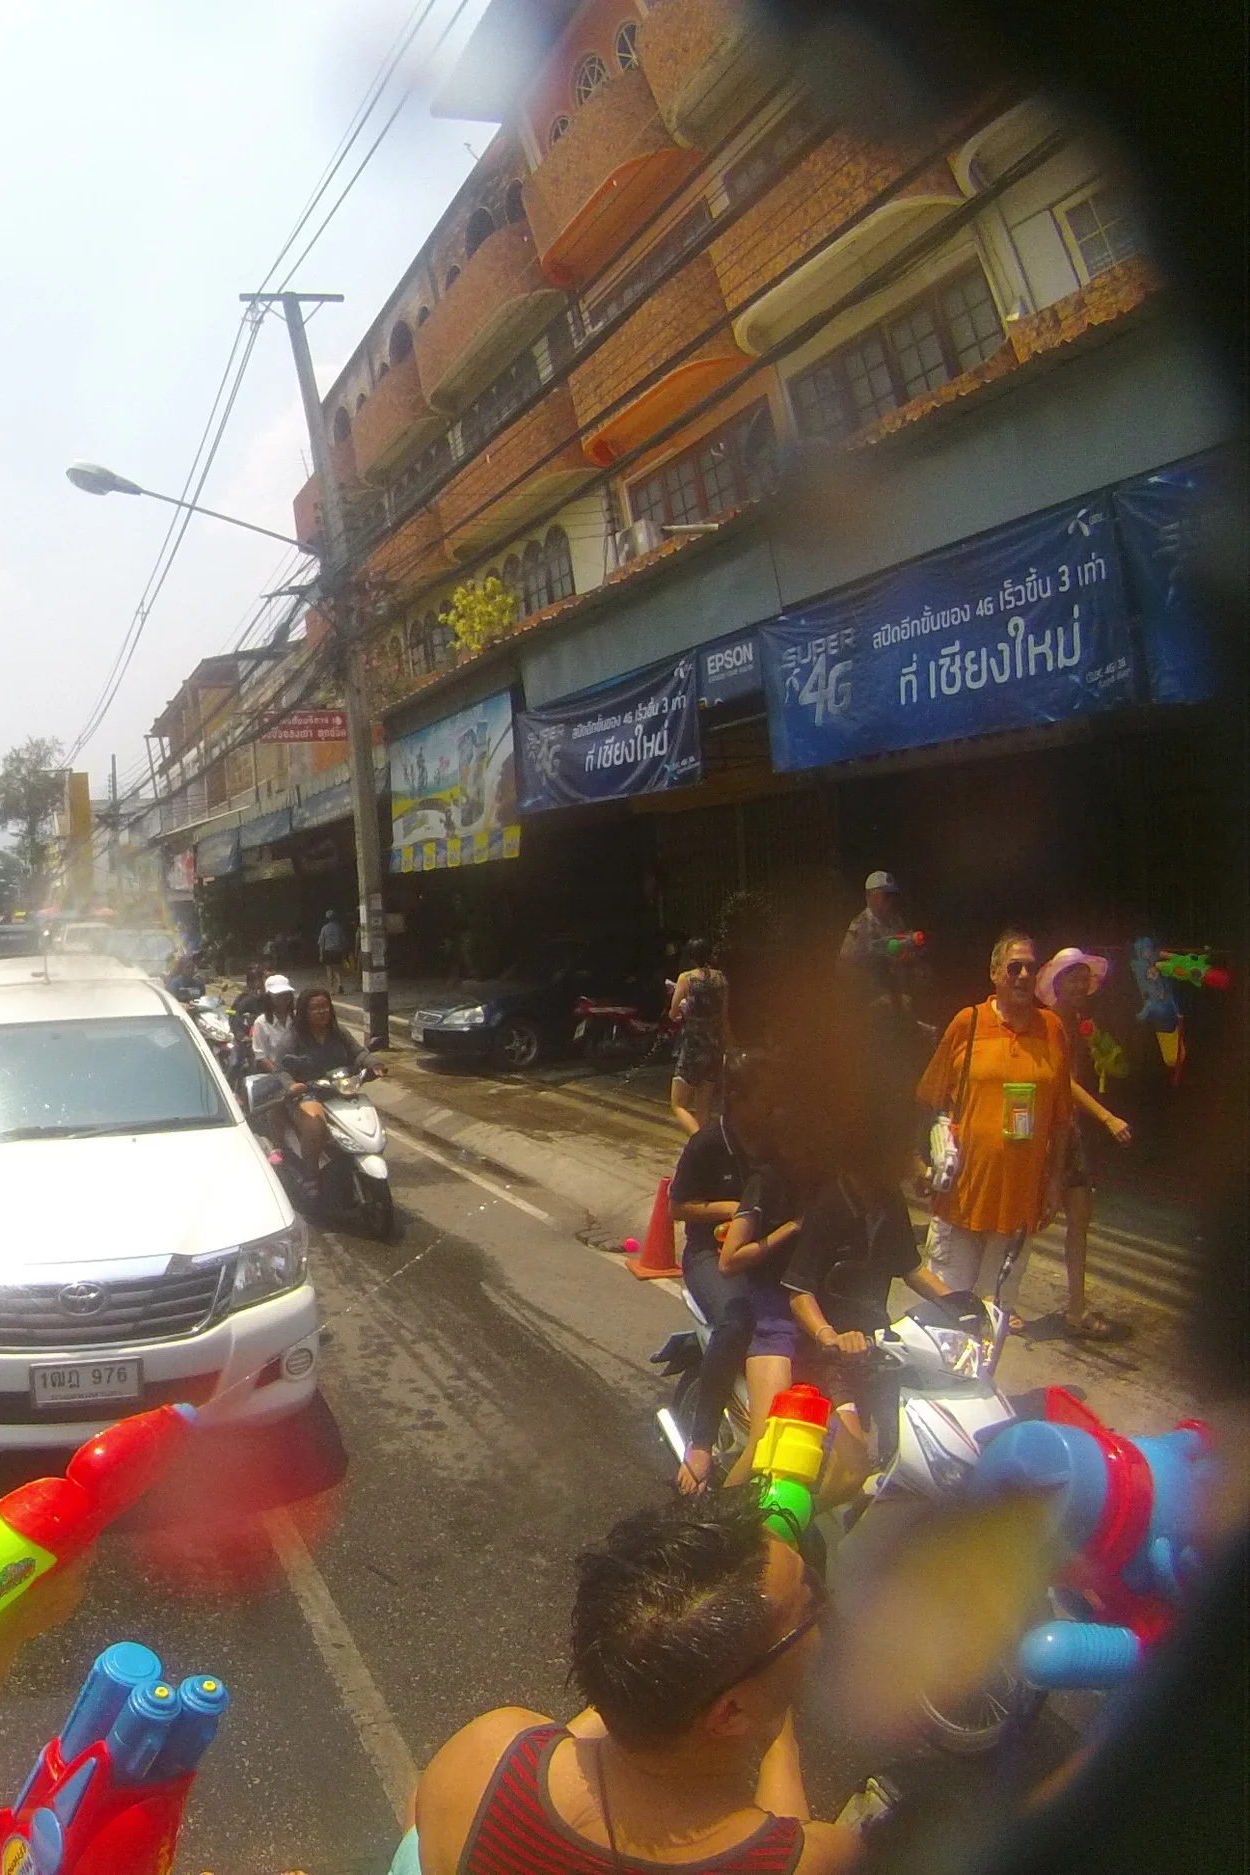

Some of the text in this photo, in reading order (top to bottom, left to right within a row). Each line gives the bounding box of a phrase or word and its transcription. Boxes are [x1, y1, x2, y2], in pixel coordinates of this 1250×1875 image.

[872, 552, 1107, 650] สปีดอีกขั้นของ 4G เร็วขึ้น 3 เท่า
[707, 642, 754, 675] EPSON
[900, 604, 1082, 706] ที่ เชียงใหม่
[662, 698, 668, 714] 3
[798, 652, 853, 727] 4G
[585, 745, 595, 773] ที่
[597, 719, 669, 770] เชียงใหม่
[91, 1366, 128, 1385] 976
